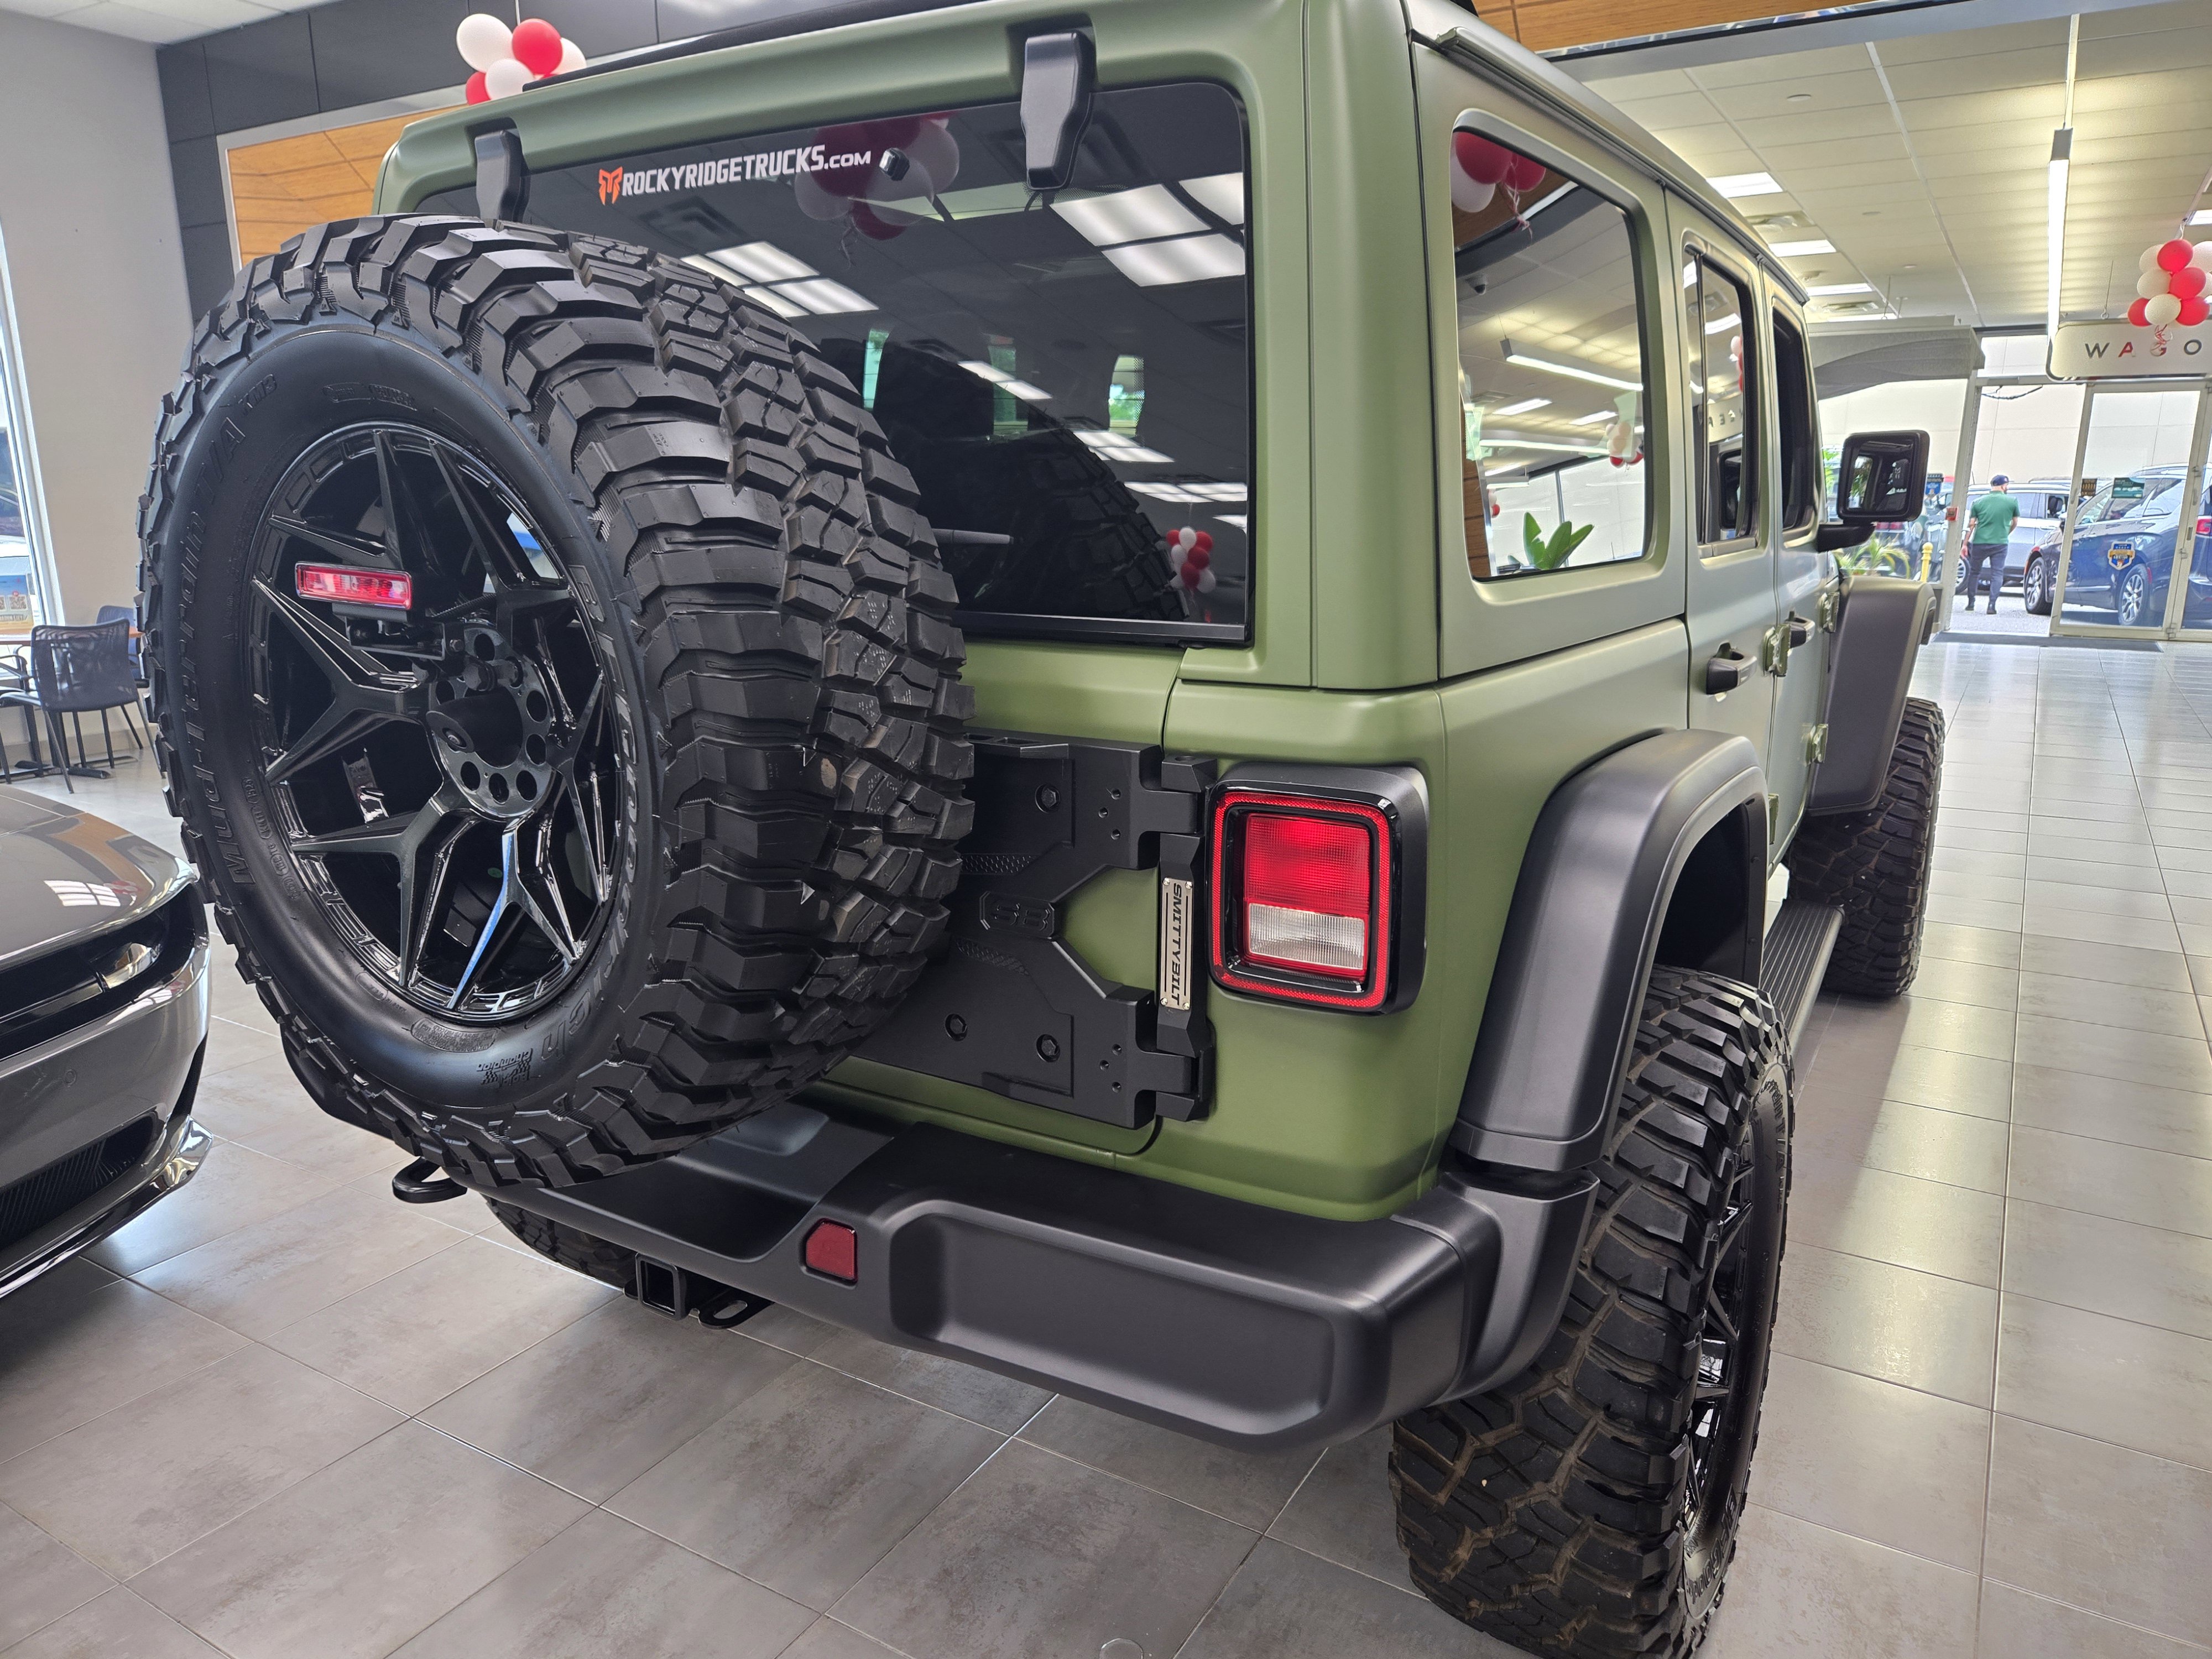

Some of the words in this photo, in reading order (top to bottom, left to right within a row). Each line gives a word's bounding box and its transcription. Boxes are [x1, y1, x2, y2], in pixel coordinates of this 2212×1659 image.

[994, 902, 1051, 931] SB
[1171, 883, 1182, 1005] SMITTYBILT
[476, 1048, 533, 1072] Champion
